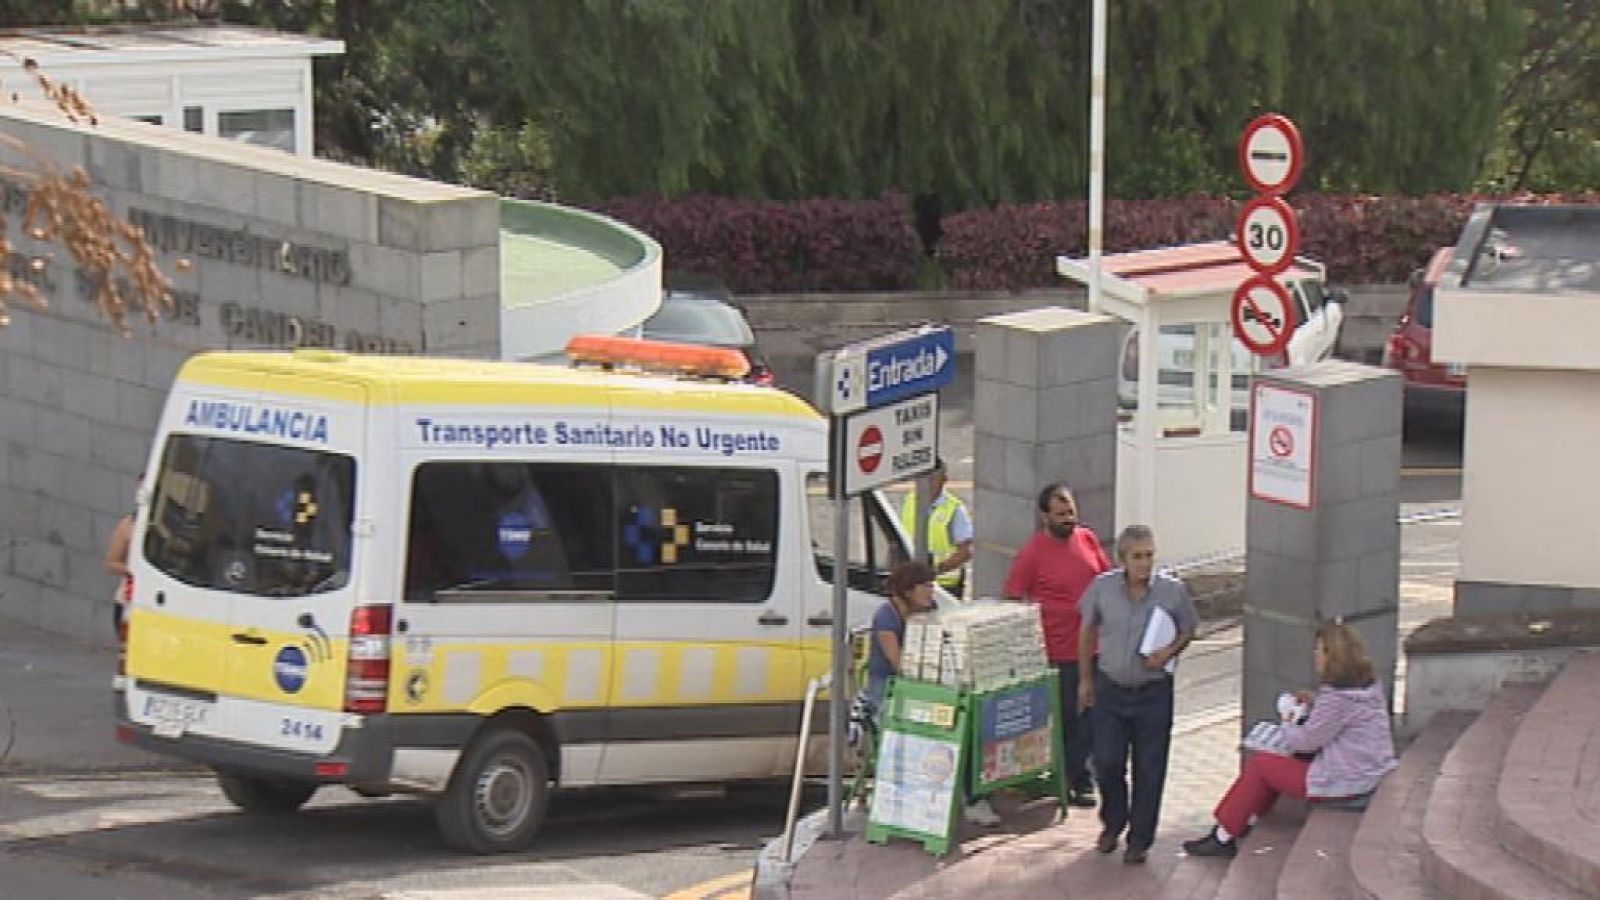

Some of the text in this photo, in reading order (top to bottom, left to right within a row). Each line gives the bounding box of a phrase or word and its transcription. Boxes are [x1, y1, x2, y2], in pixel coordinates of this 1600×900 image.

[1250, 224, 1283, 251] 30
[868, 345, 936, 391] Entrada
[186, 400, 328, 443] AMBULANCIA
[416, 417, 779, 456] Transporte Sanitario No Urgente
